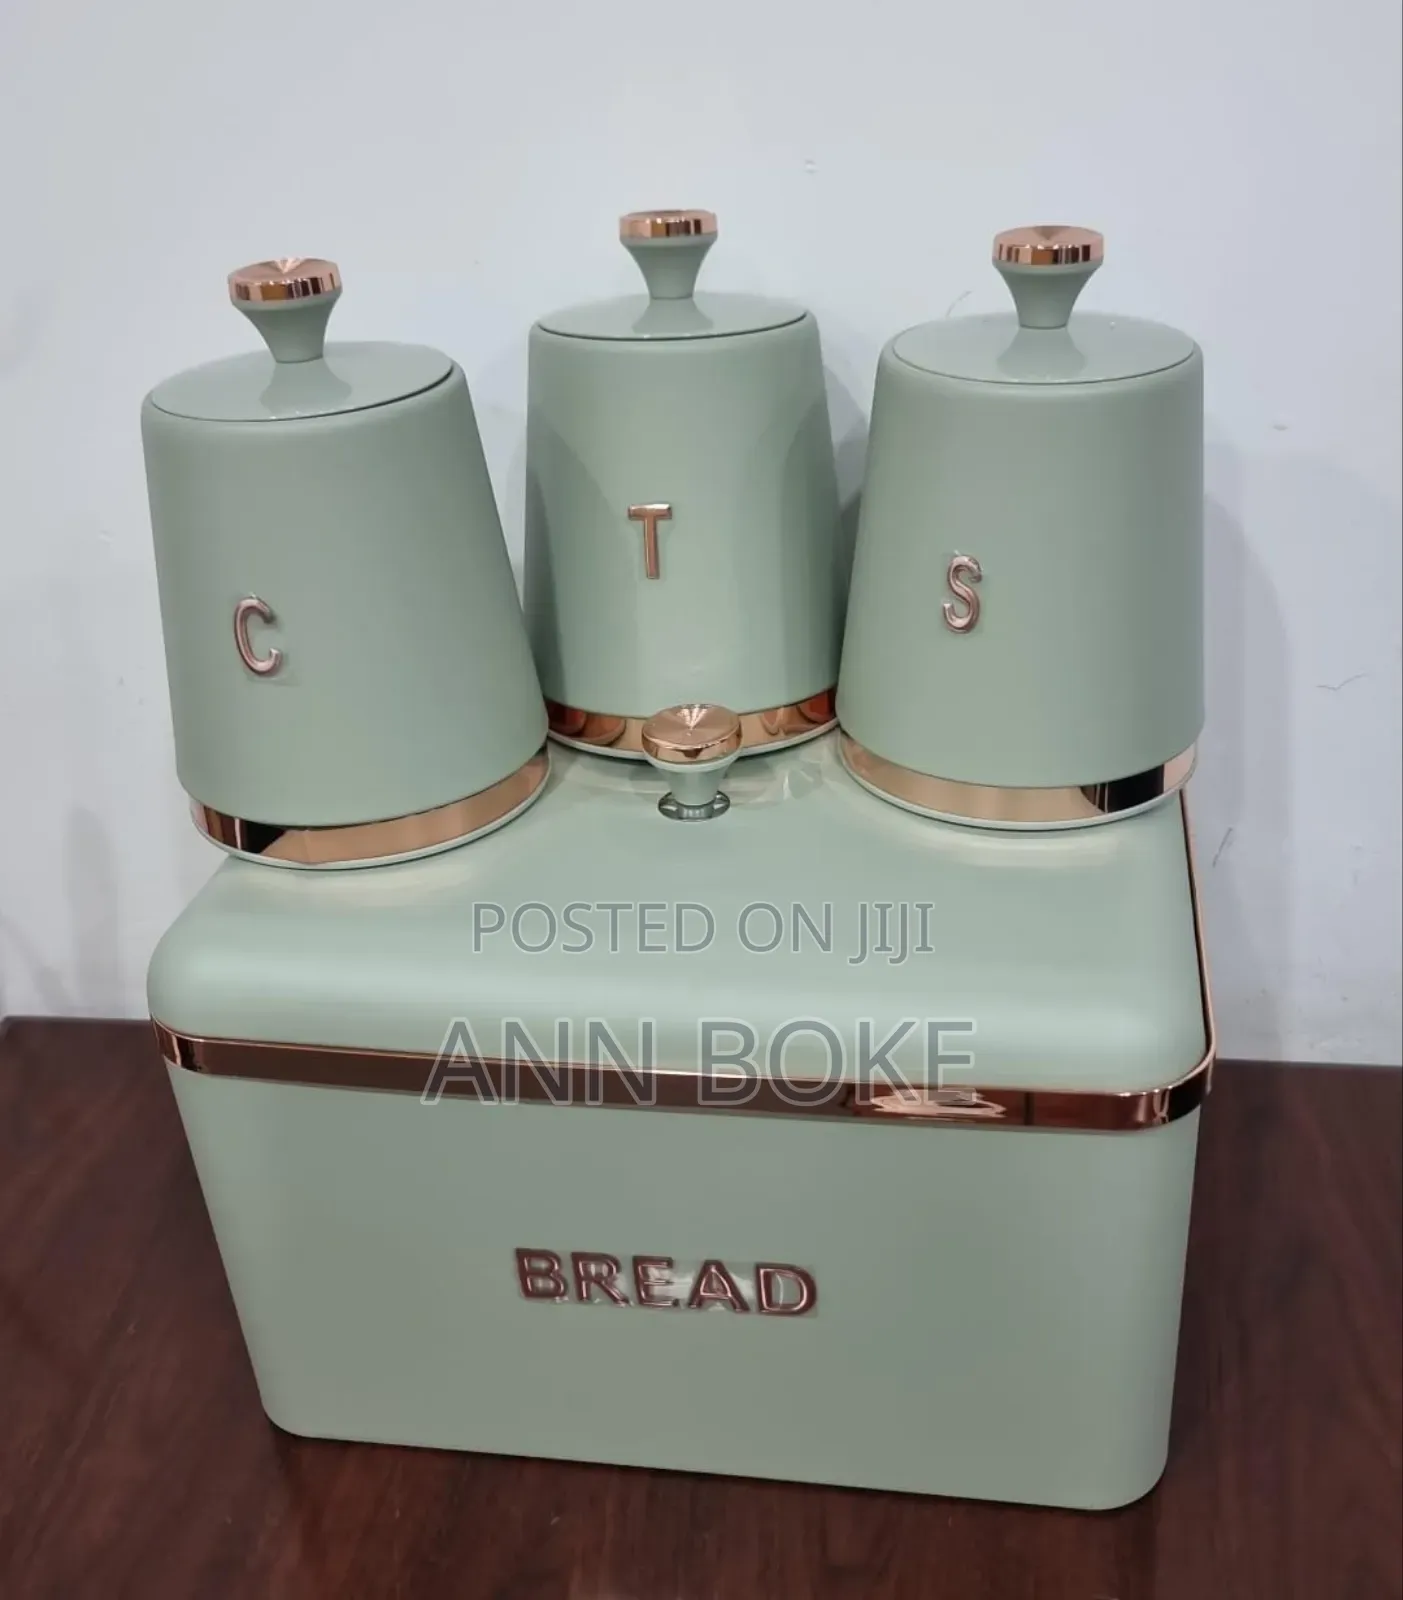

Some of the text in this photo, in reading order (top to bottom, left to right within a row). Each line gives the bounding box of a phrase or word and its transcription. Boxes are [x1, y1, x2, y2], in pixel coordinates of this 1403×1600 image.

[628, 503, 672, 580] T
[943, 555, 982, 634] S
[234, 597, 282, 677] C
[514, 1247, 818, 1316] BREAD
